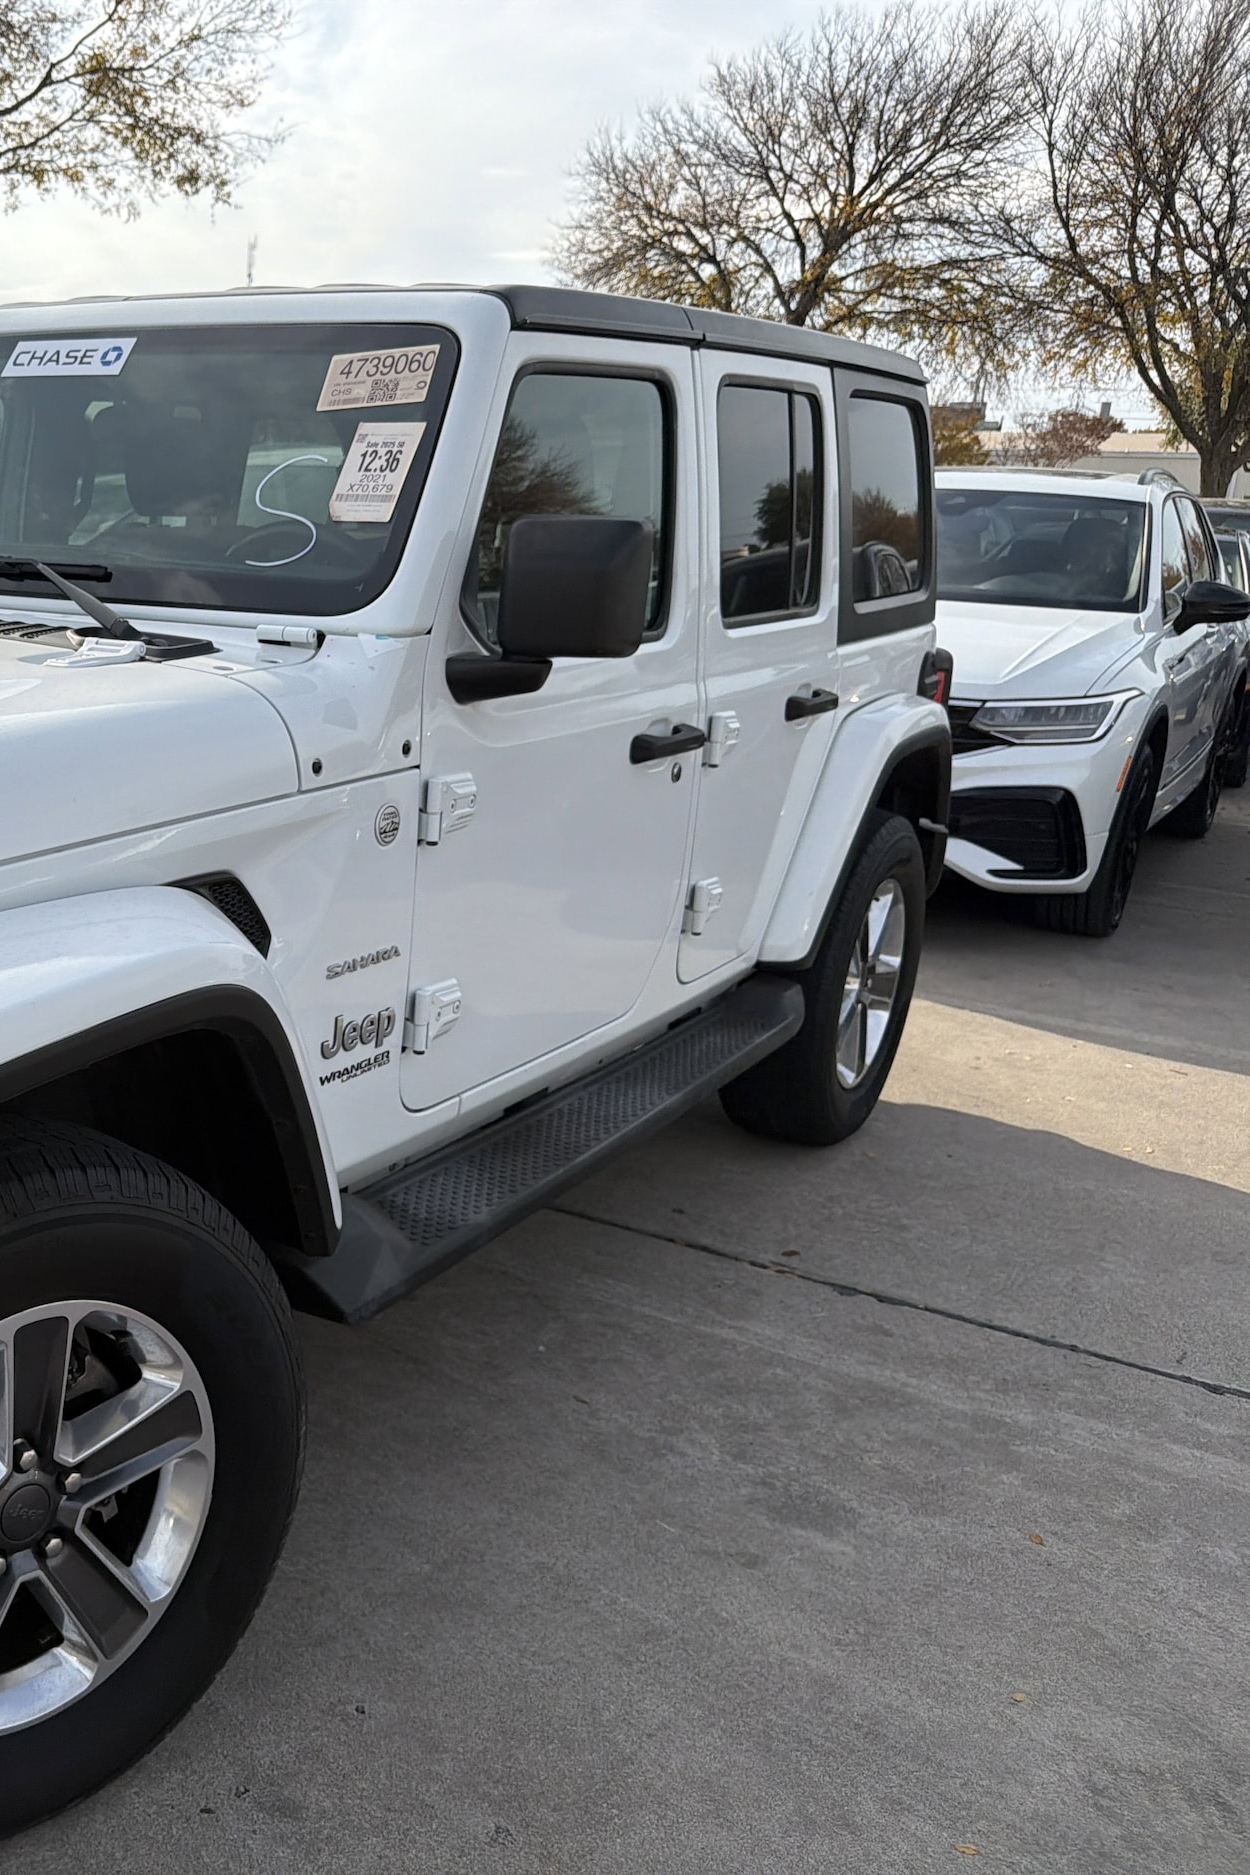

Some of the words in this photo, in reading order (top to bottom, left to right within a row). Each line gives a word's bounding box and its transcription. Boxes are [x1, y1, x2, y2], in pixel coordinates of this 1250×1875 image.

[13, 348, 99, 366] CHASE
[340, 351, 436, 379] 4739060
[357, 449, 403, 473] 12:36
[359, 474, 387, 483] 2021
[326, 945, 401, 980] SAHARA
[320, 1006, 396, 1060] Jeep
[319, 1050, 391, 1087] WRANGLER
[341, 1059, 391, 1083] UNLIMITED
